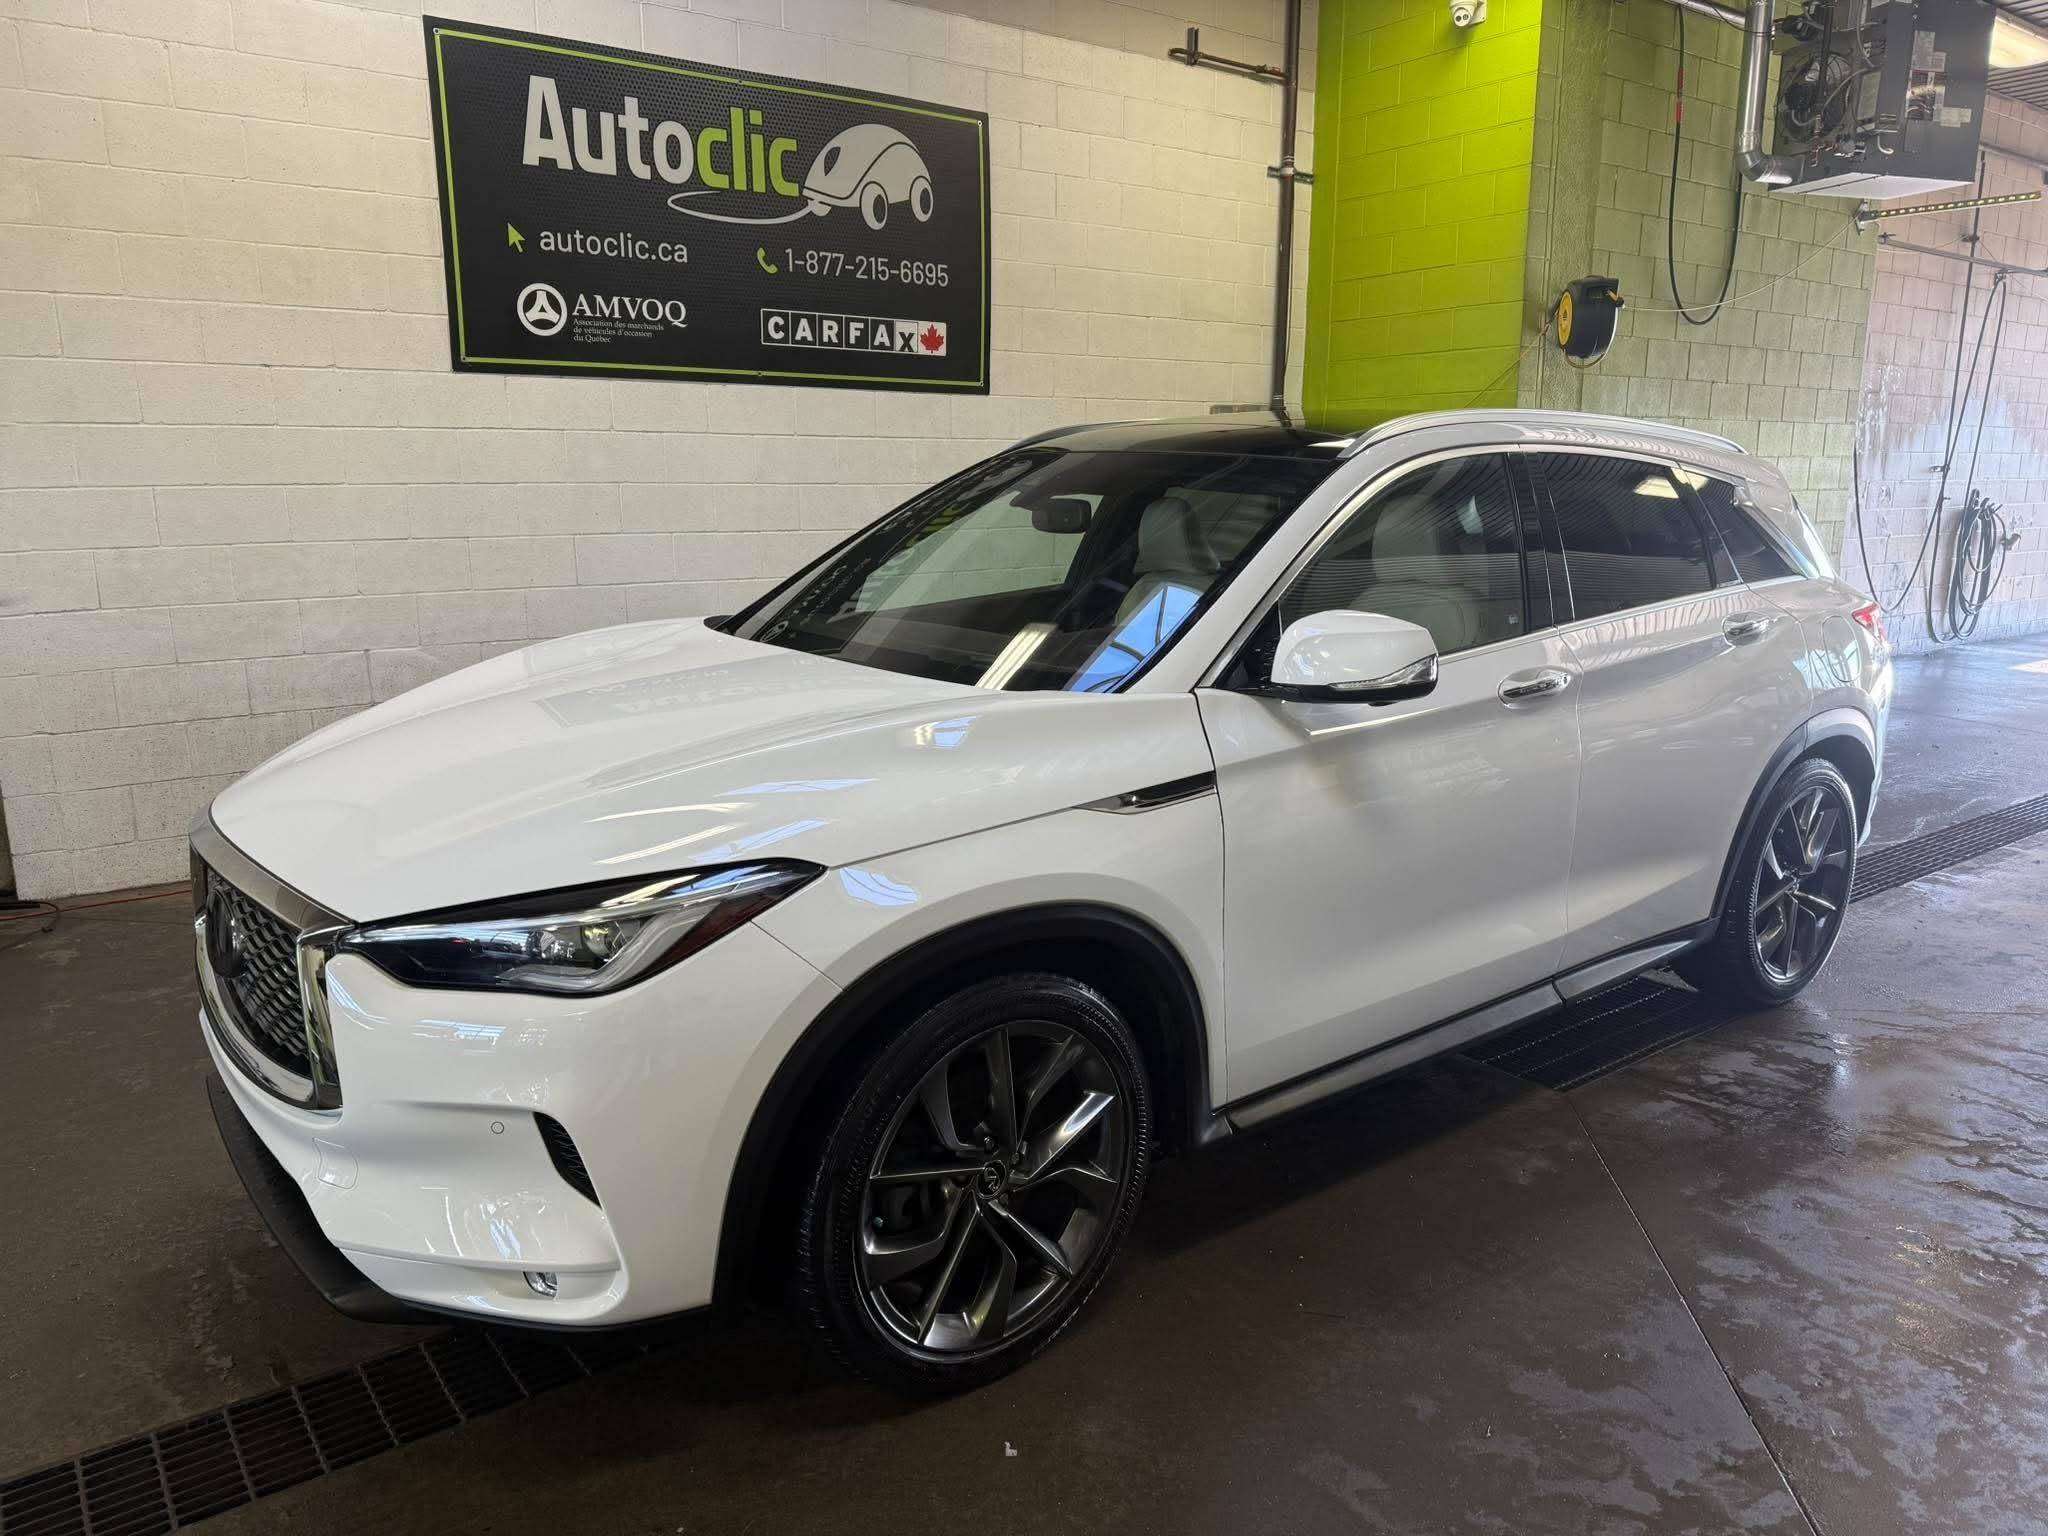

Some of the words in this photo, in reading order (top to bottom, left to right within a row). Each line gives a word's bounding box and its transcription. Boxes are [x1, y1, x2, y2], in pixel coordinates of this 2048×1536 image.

[522, 74, 799, 197] Autoclic
[539, 229, 688, 263] autoclic.ca
[785, 248, 949, 287] 1-877-215-6695
[572, 293, 688, 328] AMVOQ
[573, 319, 613, 328] Association
[614, 320, 627, 329] des
[627, 322, 664, 331] marchands
[573, 326, 583, 334] de
[584, 327, 617, 336] véhicules
[617, 329, 653, 338] d'occasion
[573, 334, 584, 342] du
[767, 315, 917, 353] CARFAX
